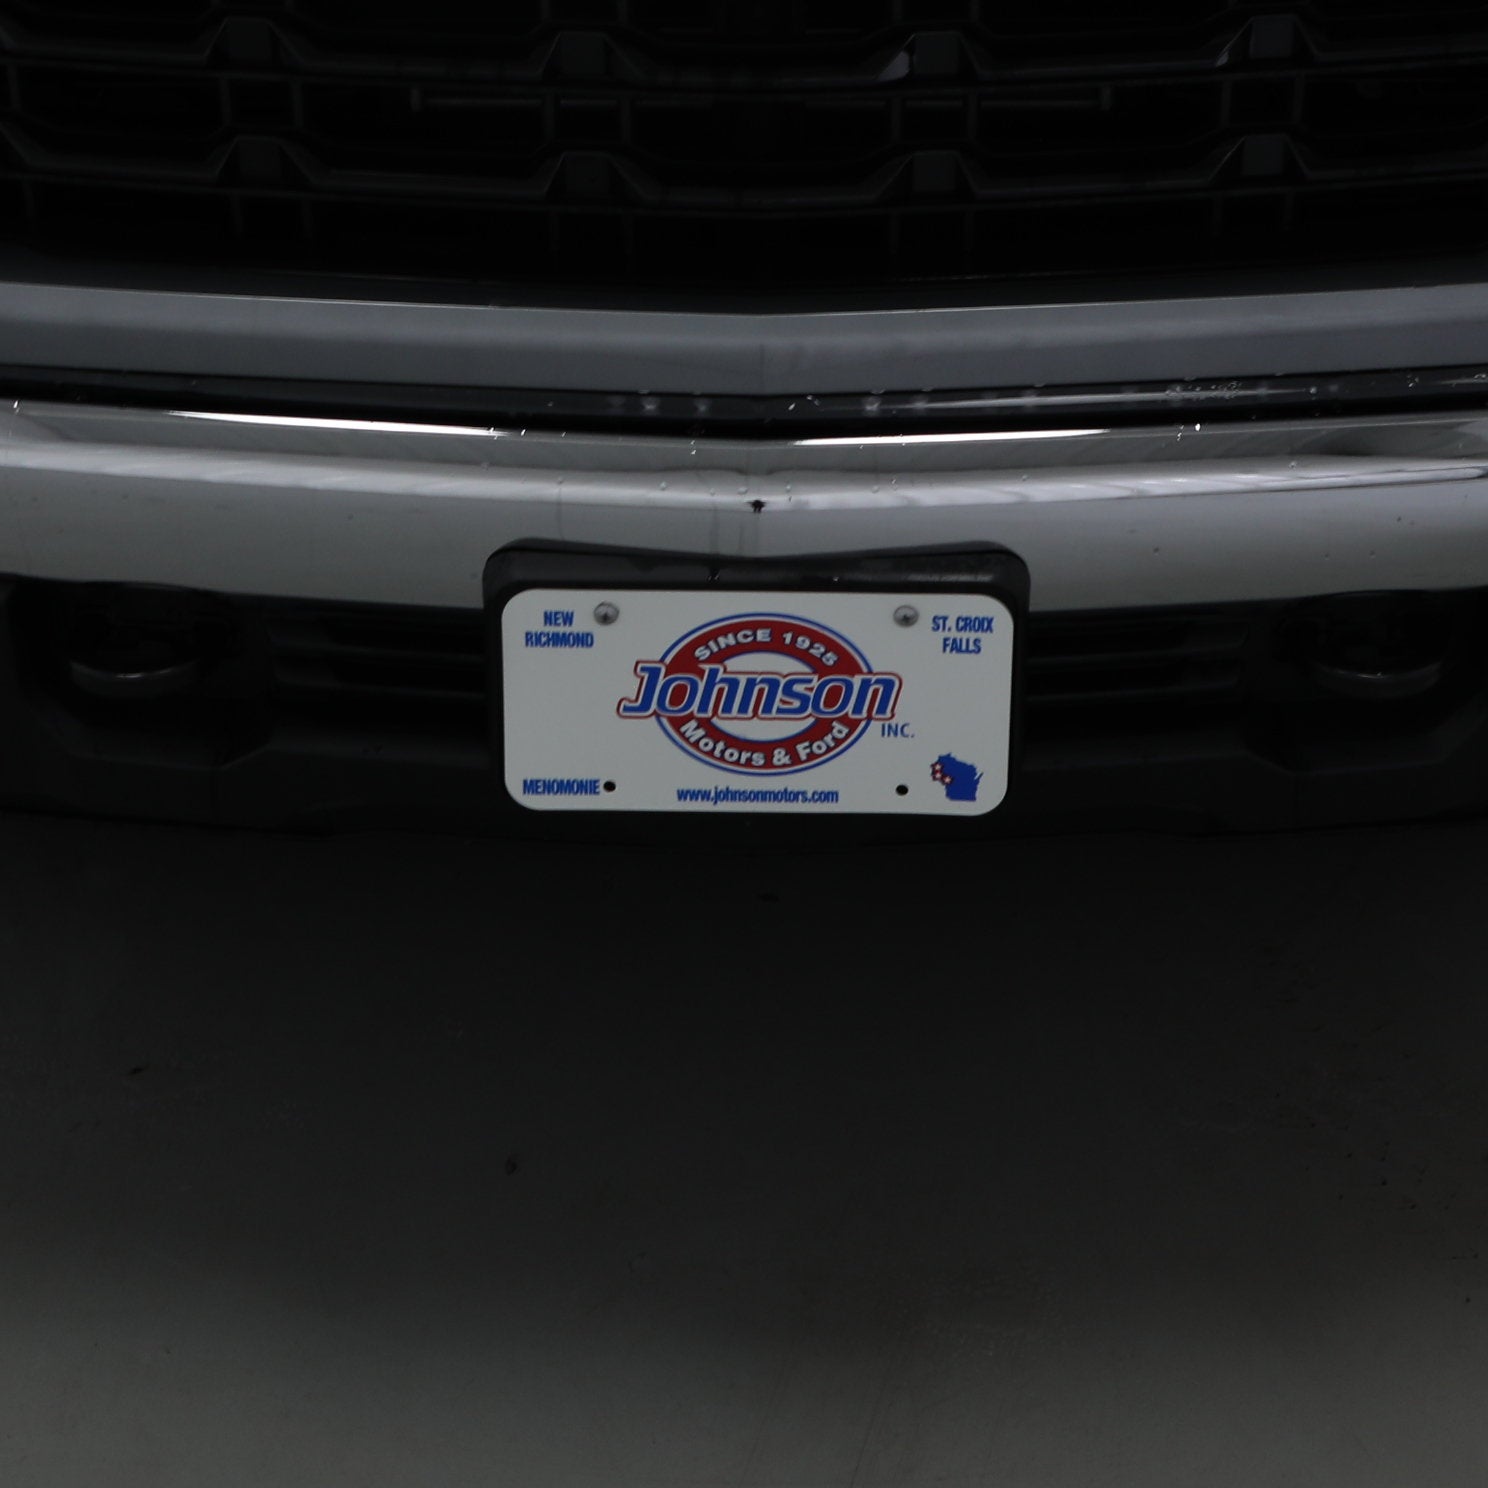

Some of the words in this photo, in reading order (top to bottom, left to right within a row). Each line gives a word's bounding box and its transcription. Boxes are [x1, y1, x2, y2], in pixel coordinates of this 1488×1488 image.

[544, 610, 574, 627] NEW
[931, 616, 952, 633] ST.
[955, 616, 994, 634] CROIX
[525, 631, 595, 648] RICHMOND
[693, 628, 772, 662] SINCE
[781, 630, 837, 667] 1925
[942, 637, 982, 654] FALLS
[619, 661, 900, 718] Johnson
[880, 723, 915, 739] INC.
[678, 719, 767, 766] Motors
[772, 748, 792, 766] &
[795, 721, 850, 761] Ford
[522, 779, 600, 795] MENOMONIE
[676, 786, 839, 805] www.johnsonmotors.com
